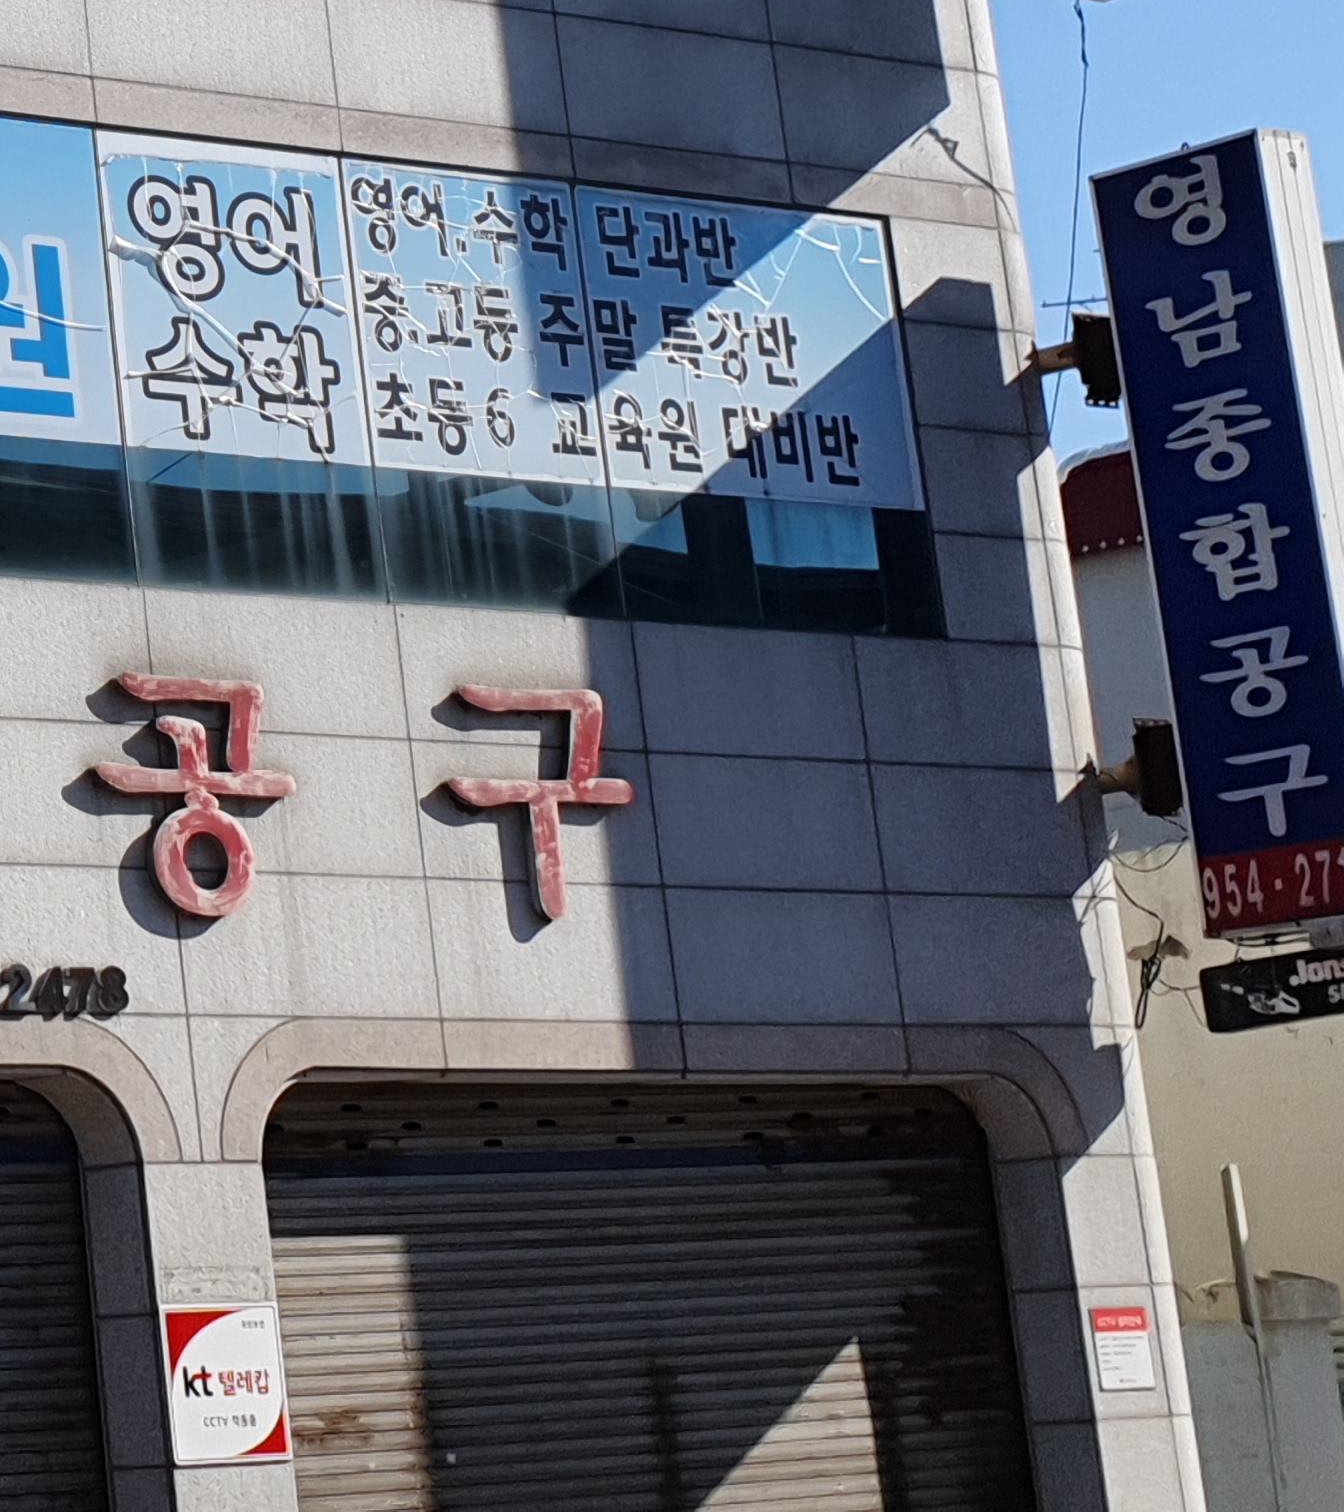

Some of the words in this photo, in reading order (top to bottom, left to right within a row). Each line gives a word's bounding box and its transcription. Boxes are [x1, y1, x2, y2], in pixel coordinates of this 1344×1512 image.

[127, 175, 323, 308] 영어
[595, 205, 738, 289] 단과반
[141, 316, 342, 455] 수학
[539, 292, 639, 373] 주말
[660, 305, 800, 388] 특강반
[550, 390, 706, 474] 교육원
[722, 406, 862, 488] 대비반
[1134, 152, 1329, 838] 영남종합공구
[183, 1366, 214, 1398] kt
[218, 1369, 270, 1396] 텔레캅
[203, 1415, 228, 1428] CCTV
